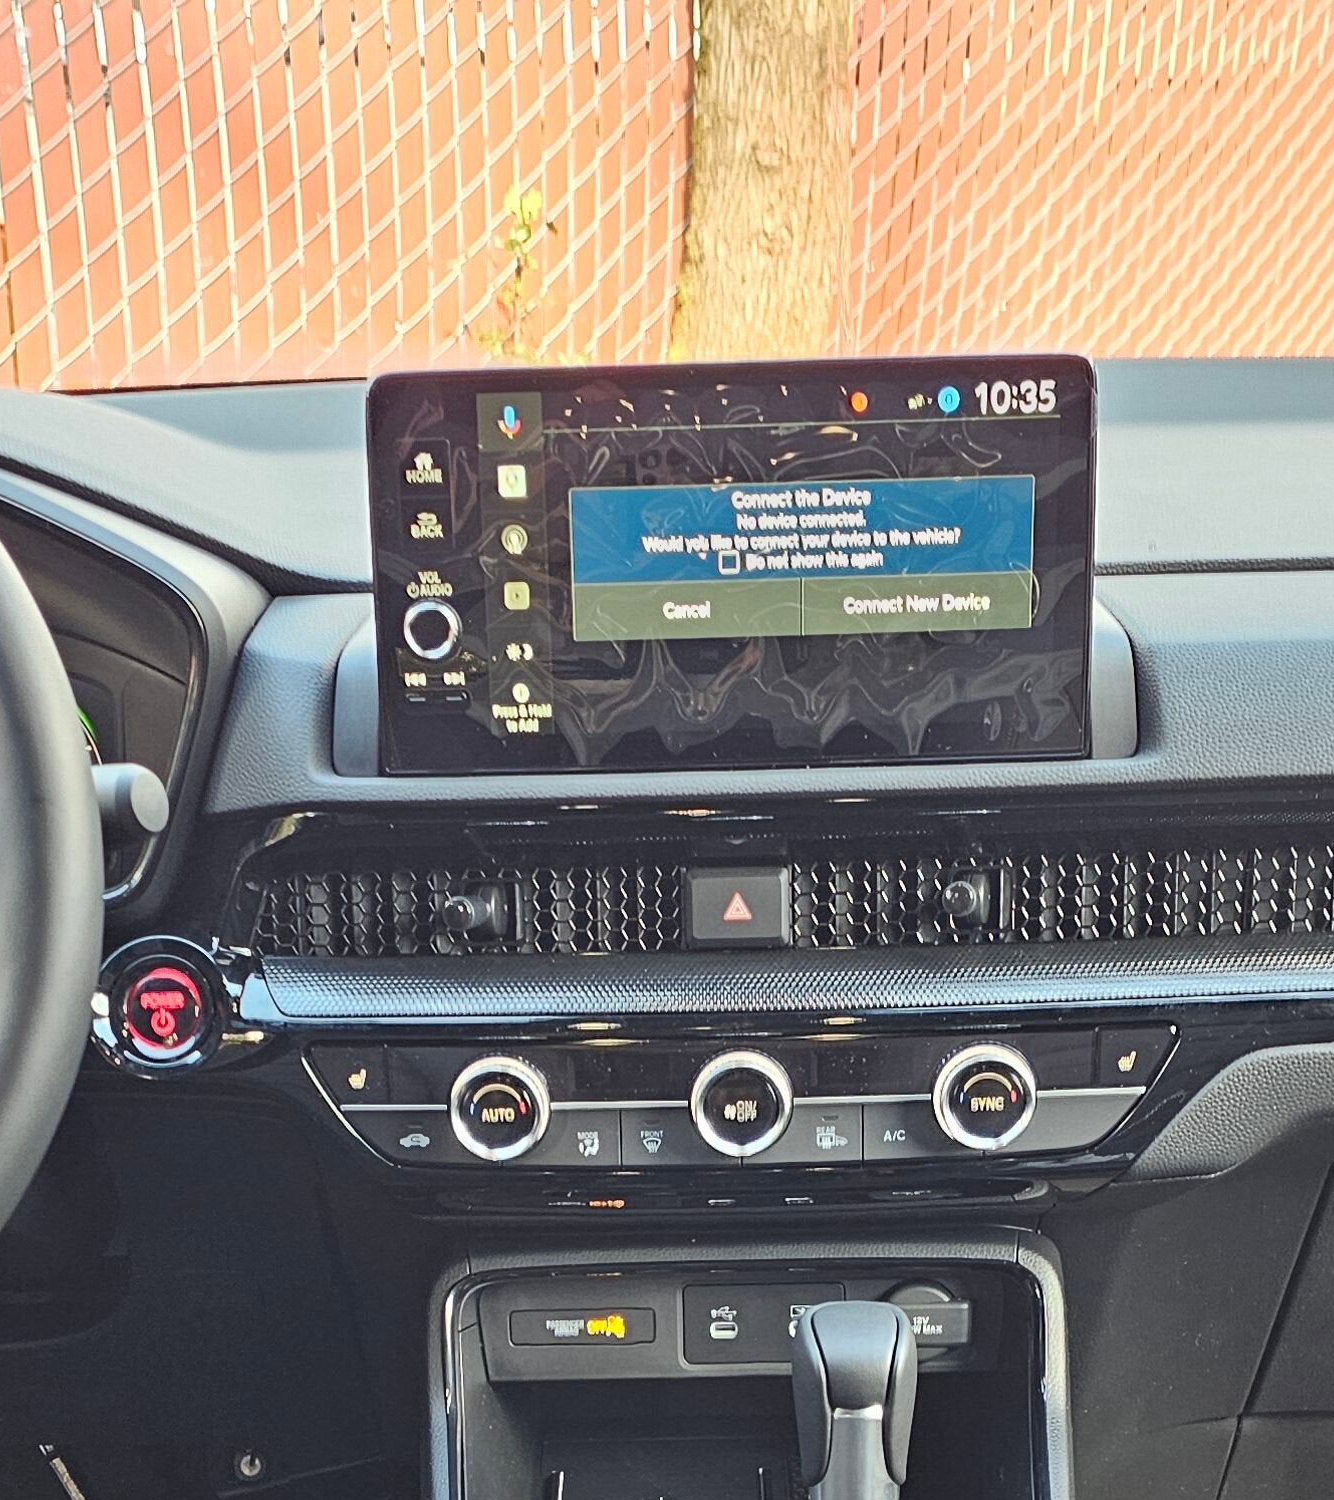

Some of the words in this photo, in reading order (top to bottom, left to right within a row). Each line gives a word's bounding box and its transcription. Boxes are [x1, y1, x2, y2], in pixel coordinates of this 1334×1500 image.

[975, 379, 1056, 415] 10:35
[406, 469, 443, 484] HOME
[731, 491, 793, 510] Connect
[795, 488, 819, 507] the
[822, 487, 871, 507] Device
[737, 514, 756, 530] No
[758, 512, 797, 530] device
[410, 523, 444, 539] BACK
[642, 535, 683, 552] Would
[710, 534, 733, 551] like
[734, 534, 748, 550] to
[750, 533, 799, 550] connect
[801, 533, 830, 551] your
[831, 530, 871, 548] device
[873, 530, 887, 547] to
[889, 529, 910, 547] the
[912, 527, 961, 546] vehicle?
[767, 551, 789, 570] not
[791, 551, 824, 570] show
[825, 551, 849, 569] this
[850, 550, 884, 570] again
[418, 571, 441, 584] VOL
[420, 583, 453, 597] AUDIO
[663, 600, 711, 620] Cancel
[843, 595, 903, 614] Connect
[906, 594, 939, 612] New
[942, 592, 990, 611] Device
[970, 1096, 1004, 1112] SYNC
[481, 1107, 515, 1123] AUTO
[640, 1130, 664, 1139] FRONT
[816, 1126, 836, 1135] REAR
[883, 1130, 906, 1142] A/C
